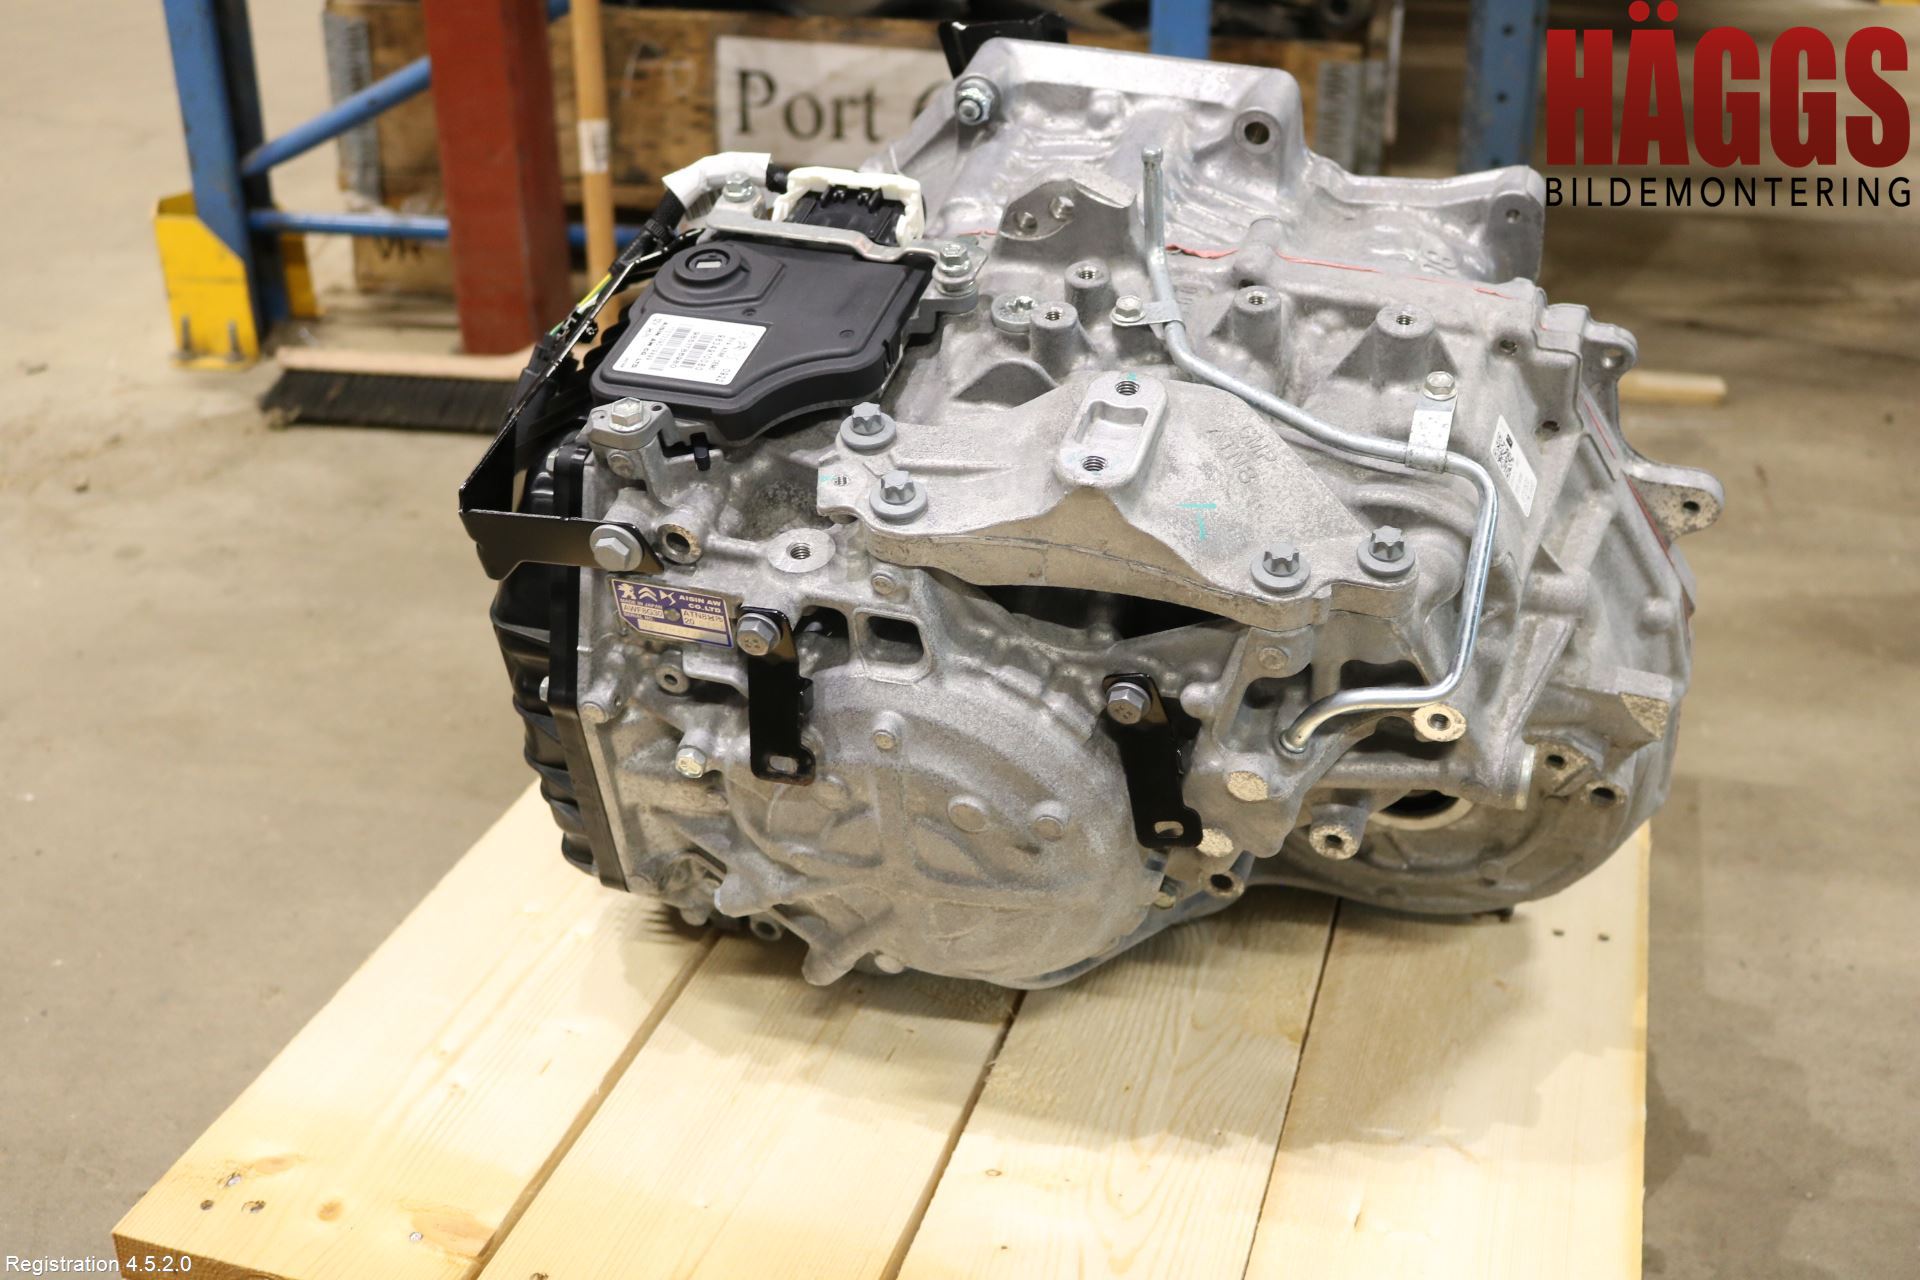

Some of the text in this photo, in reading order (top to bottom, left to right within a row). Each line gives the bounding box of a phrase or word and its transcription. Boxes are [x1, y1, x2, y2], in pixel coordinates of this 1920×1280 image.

[736, 68, 881, 142] Port
[679, 594, 721, 607] AISIN AW
